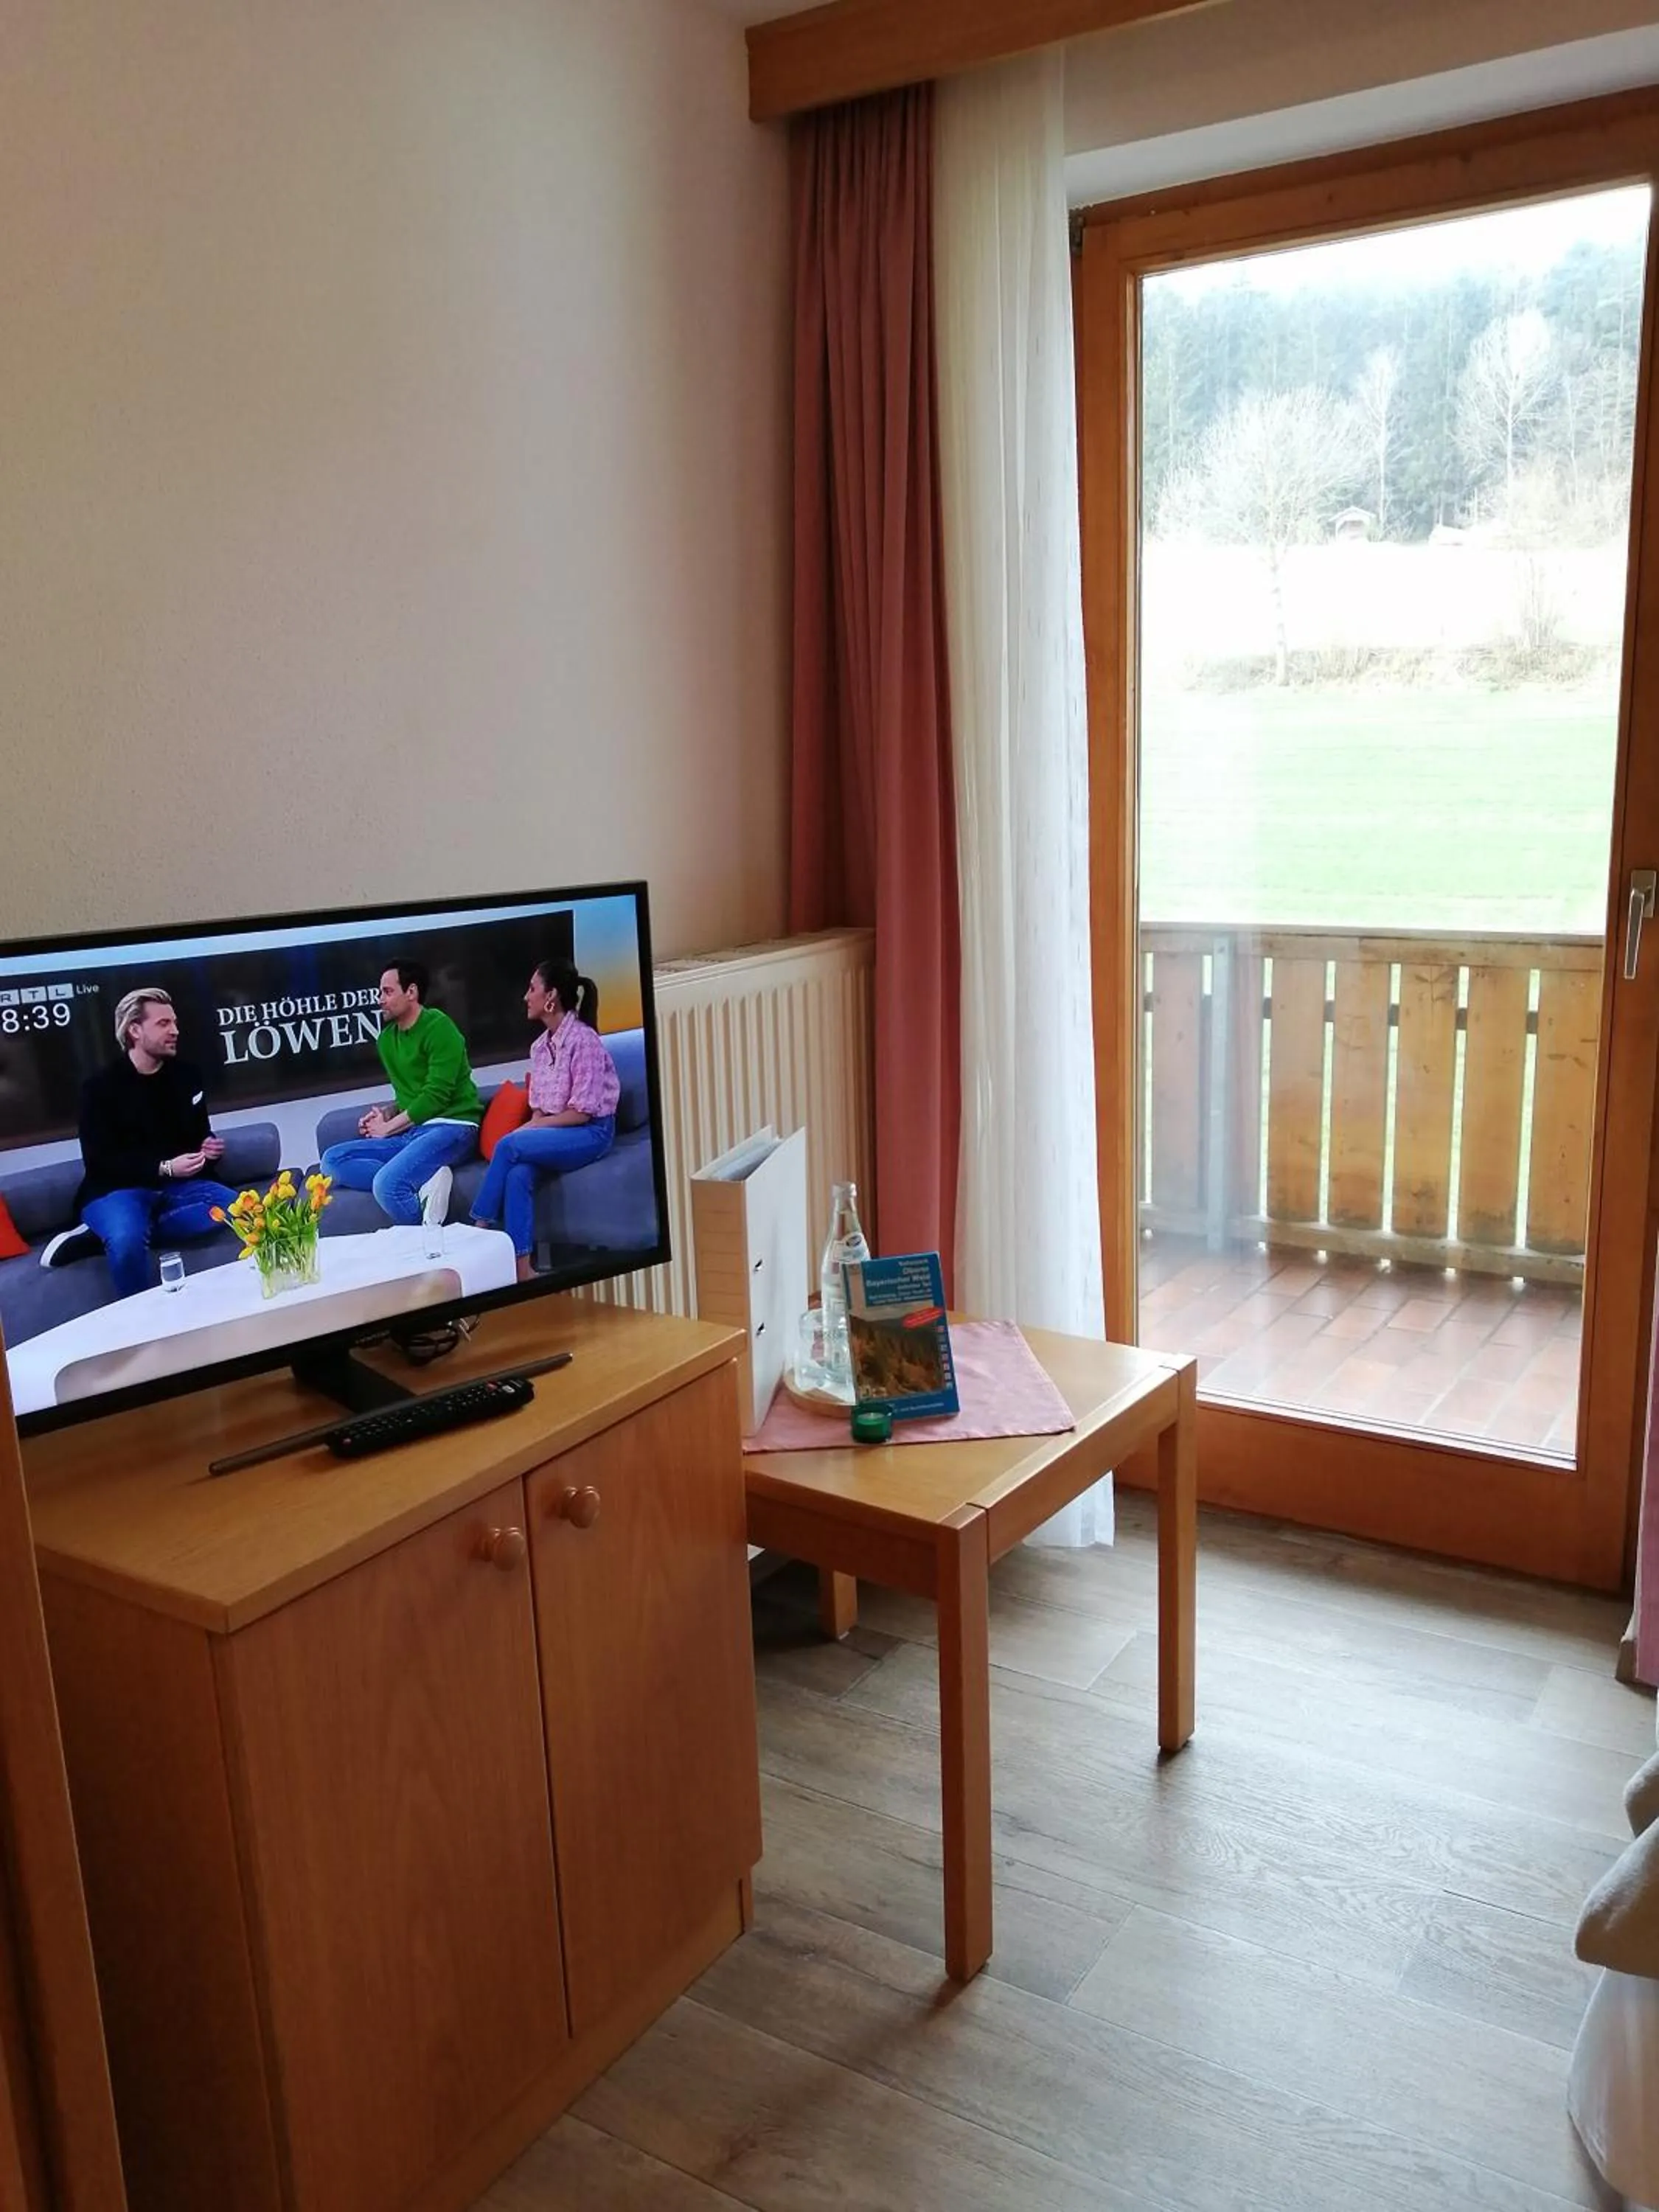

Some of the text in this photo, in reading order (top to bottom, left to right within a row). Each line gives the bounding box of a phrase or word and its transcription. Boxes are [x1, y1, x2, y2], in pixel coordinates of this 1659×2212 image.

[0, 984, 100, 1003] RTL Live
[216, 987, 382, 1026] DIE HÖHLE DER
[1, 1003, 71, 1033] 8:39
[220, 1009, 385, 1065] LÖWEN
